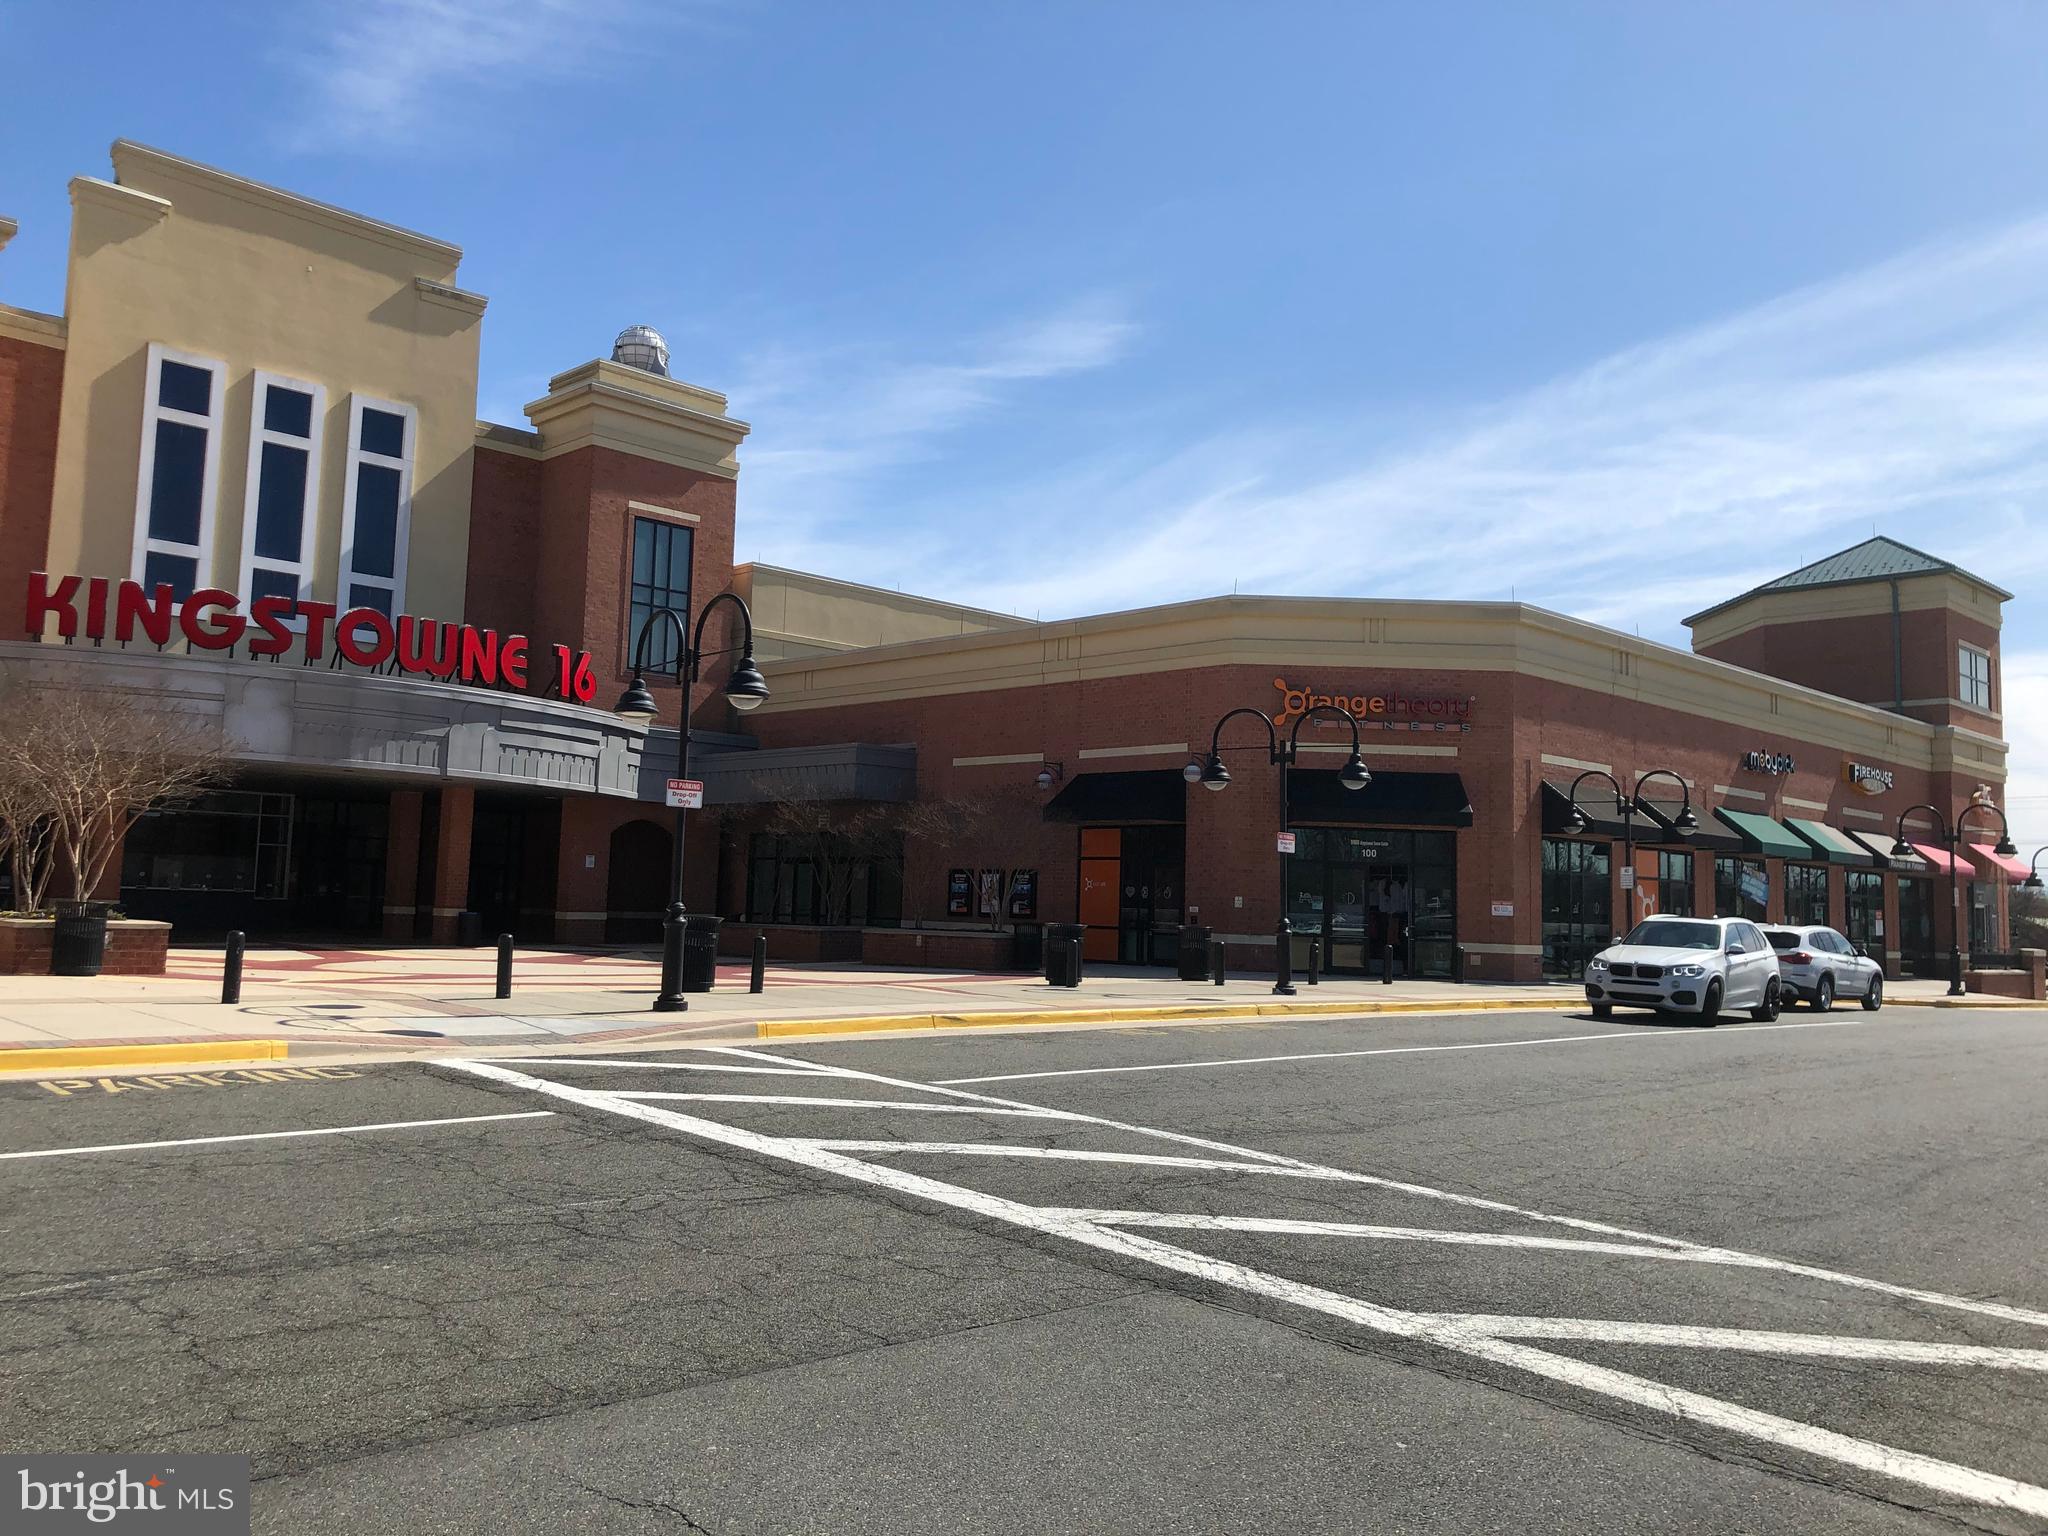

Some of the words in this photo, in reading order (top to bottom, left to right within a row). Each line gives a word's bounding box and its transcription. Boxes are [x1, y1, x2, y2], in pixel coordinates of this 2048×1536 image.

[25, 571, 528, 689] KINGSTOWNE
[553, 644, 597, 702] 16
[1313, 719, 1472, 732] FITNESS
[1854, 764, 1893, 788] FIREHOUSE
[678, 782, 701, 790] PARKING
[672, 791, 698, 799] Drop-Off
[1362, 849, 1377, 858] 100
[38, 1067, 361, 1096] PARKING
